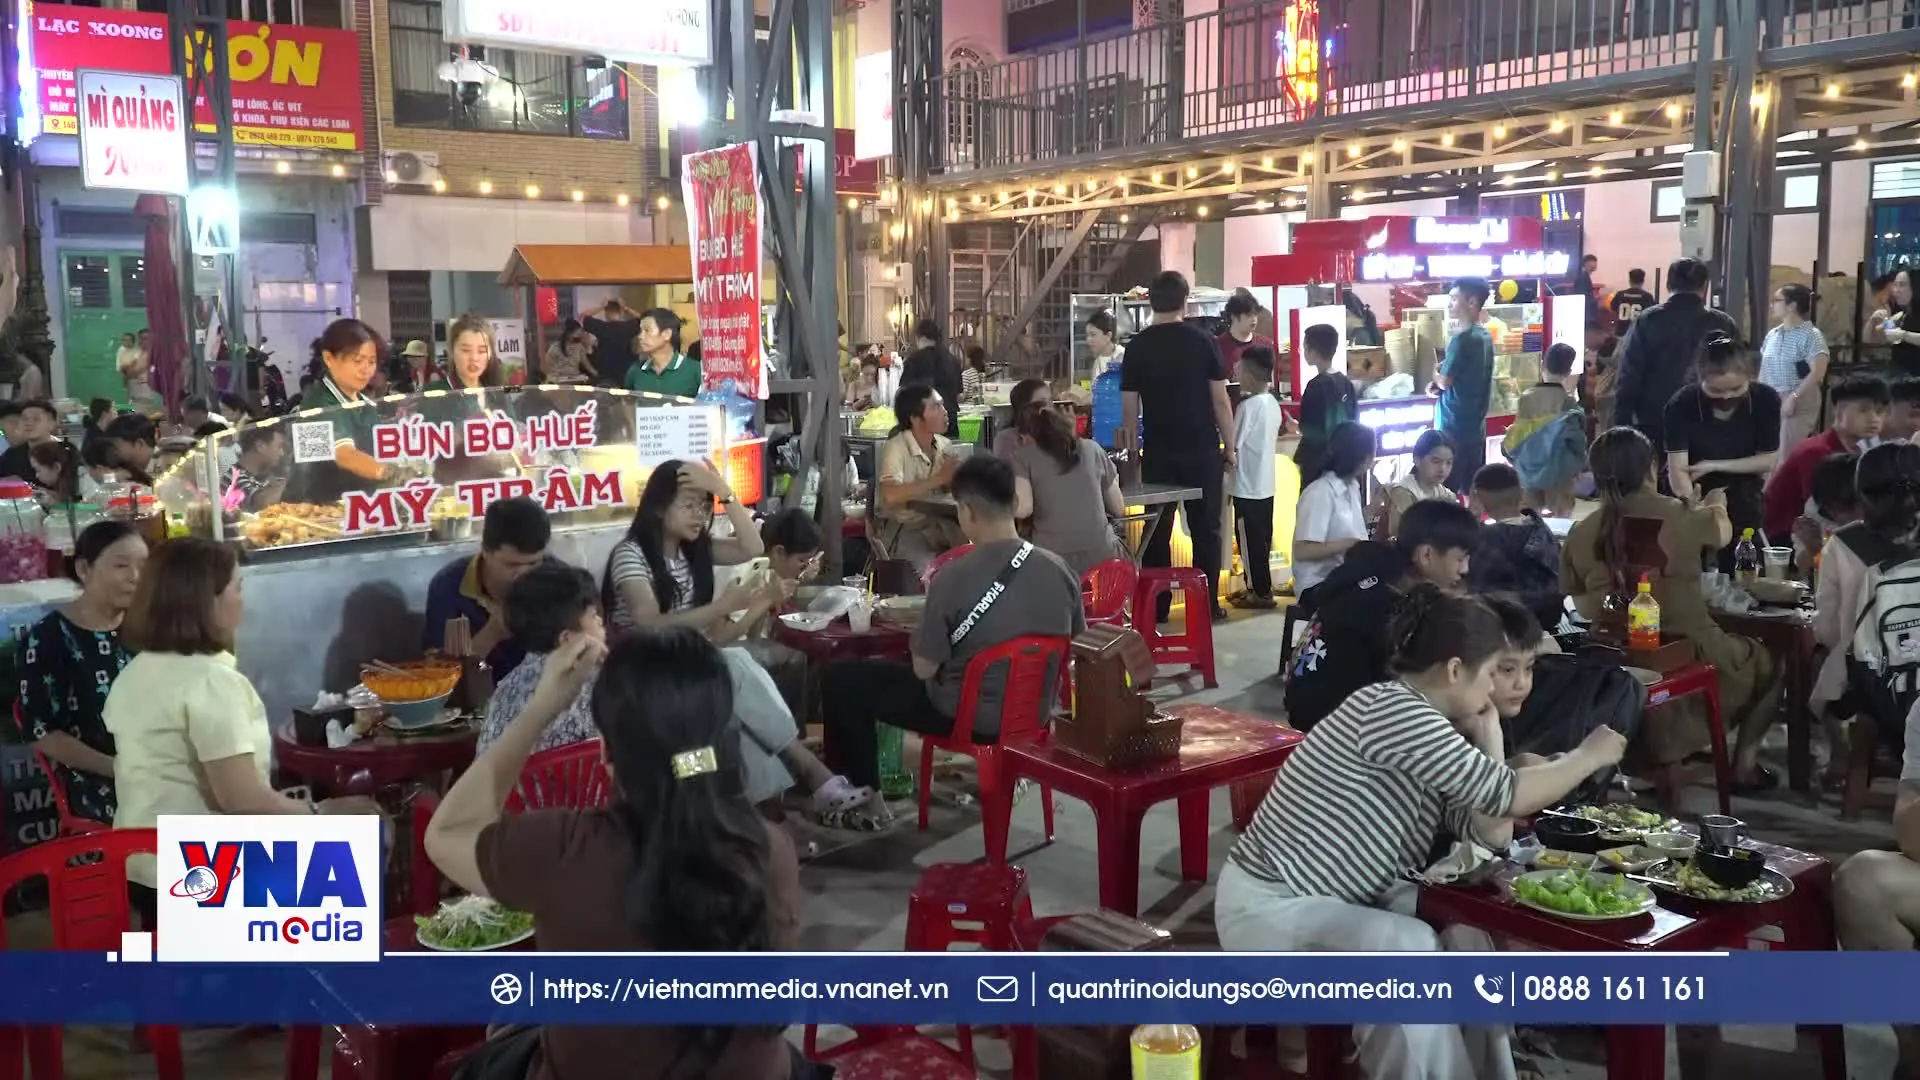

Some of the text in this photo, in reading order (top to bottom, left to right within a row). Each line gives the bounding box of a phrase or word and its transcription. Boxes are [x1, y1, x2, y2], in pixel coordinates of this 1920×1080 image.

[37, 16, 164, 40] LẠC XOONG
[87, 84, 175, 132] MÌ QUẢNG
[374, 400, 597, 462] BÚN BÒ HUẾ
[344, 478, 438, 532] MỸ
